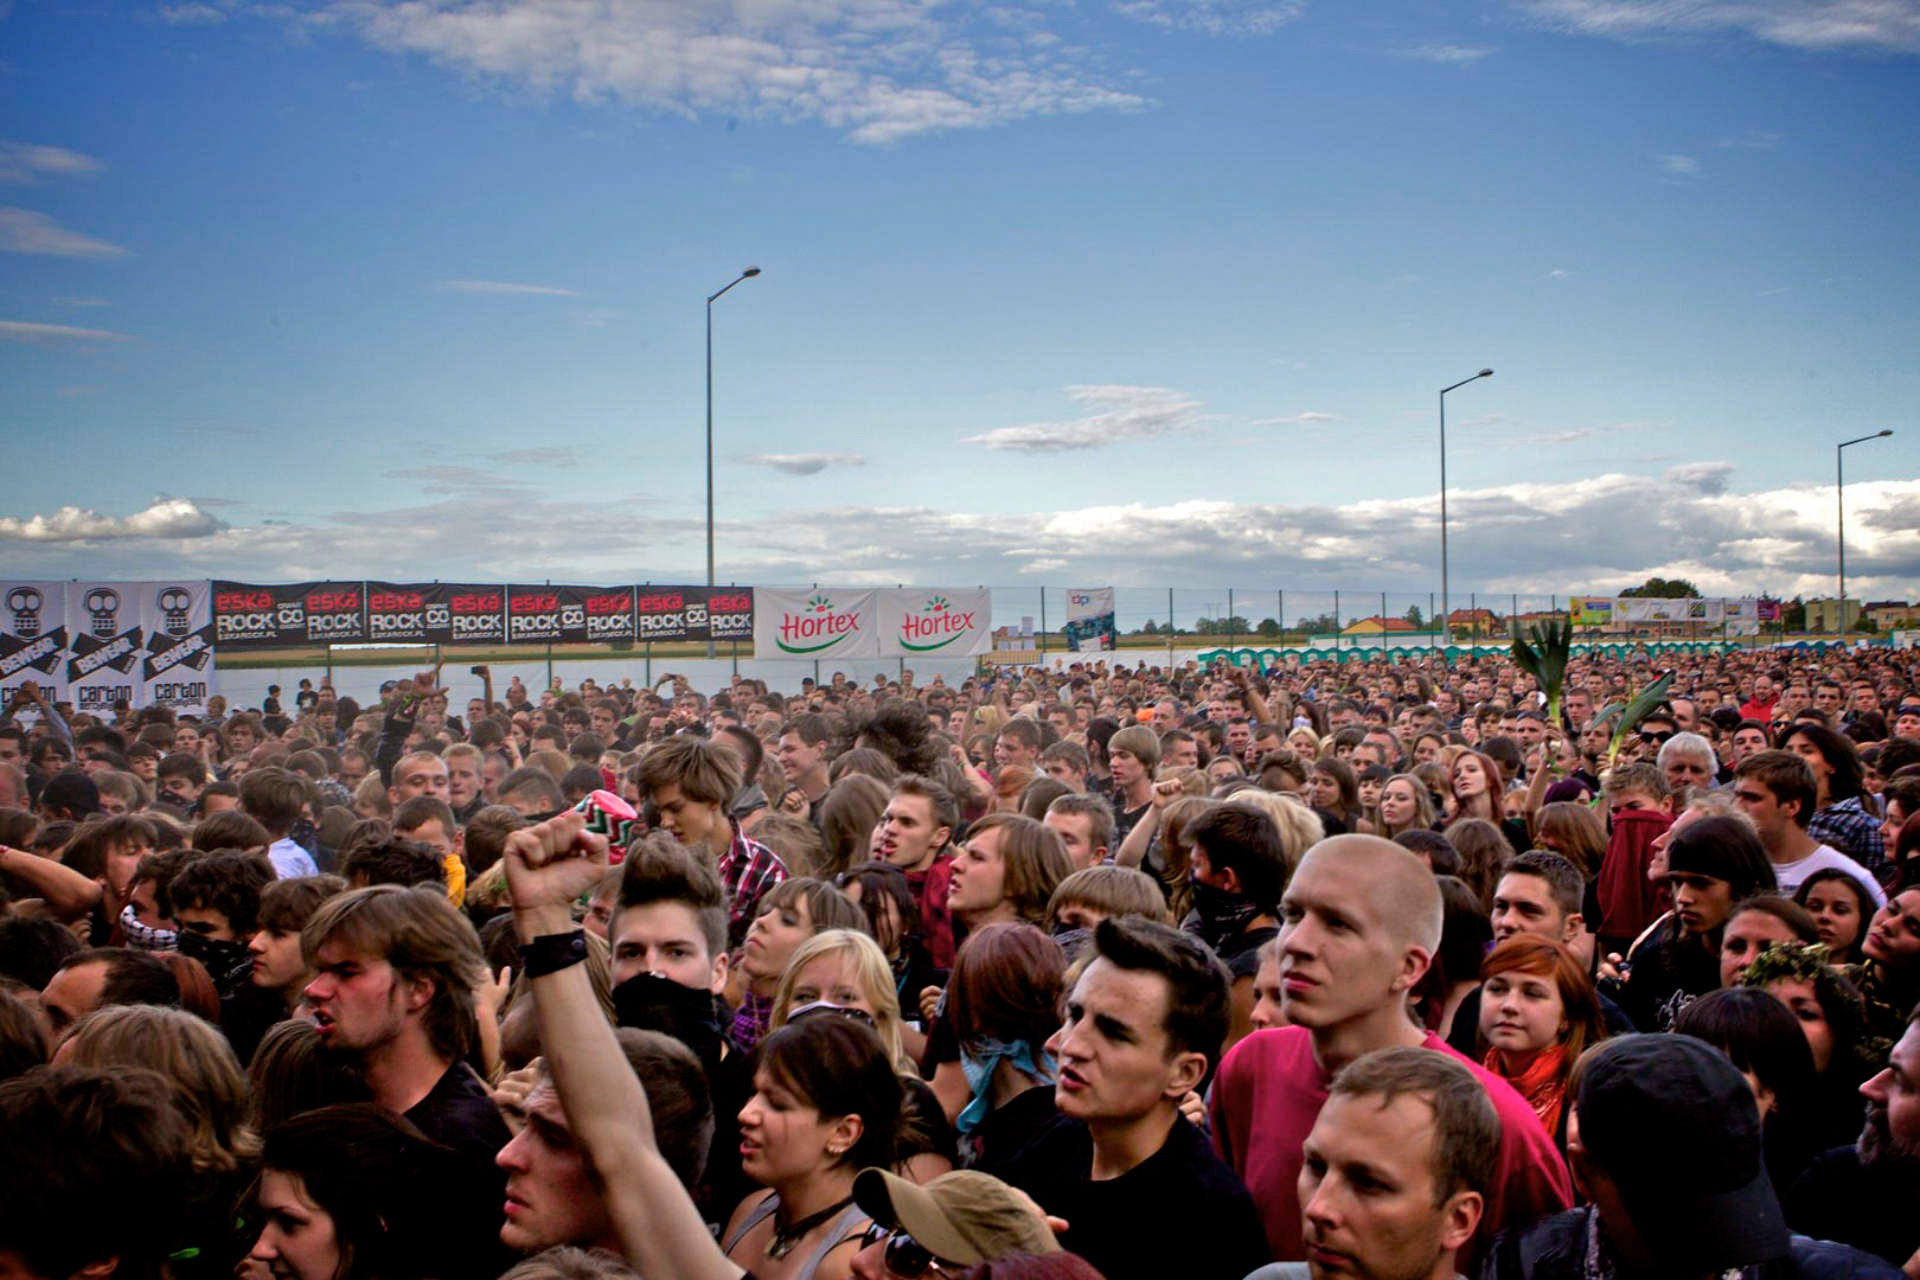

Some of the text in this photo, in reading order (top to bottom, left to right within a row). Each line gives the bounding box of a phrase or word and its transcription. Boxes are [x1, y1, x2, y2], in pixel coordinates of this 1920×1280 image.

[215, 592, 272, 611] eska
[307, 592, 360, 611] eska
[370, 592, 422, 611] eska
[452, 593, 500, 612] eska
[511, 594, 557, 612] eska
[587, 594, 632, 612] eska
[640, 594, 684, 611] eska
[709, 595, 751, 611] eska
[216, 613, 275, 632] ROCK
[278, 609, 304, 624] CO
[308, 612, 361, 632] ROCK
[370, 613, 424, 630] ROCK
[426, 610, 449, 624] CO
[453, 615, 502, 632] ROCK
[511, 614, 560, 632] ROCK
[562, 611, 584, 624] CO
[587, 614, 632, 631] ROCK
[640, 614, 685, 630] ROCK
[686, 610, 708, 623] CO
[710, 614, 751, 631] ROCK
[780, 611, 861, 643] Hortex
[902, 611, 976, 642] Hortex
[2, 686, 56, 703] caon
[79, 685, 132, 702] carton
[155, 682, 206, 699] carton
